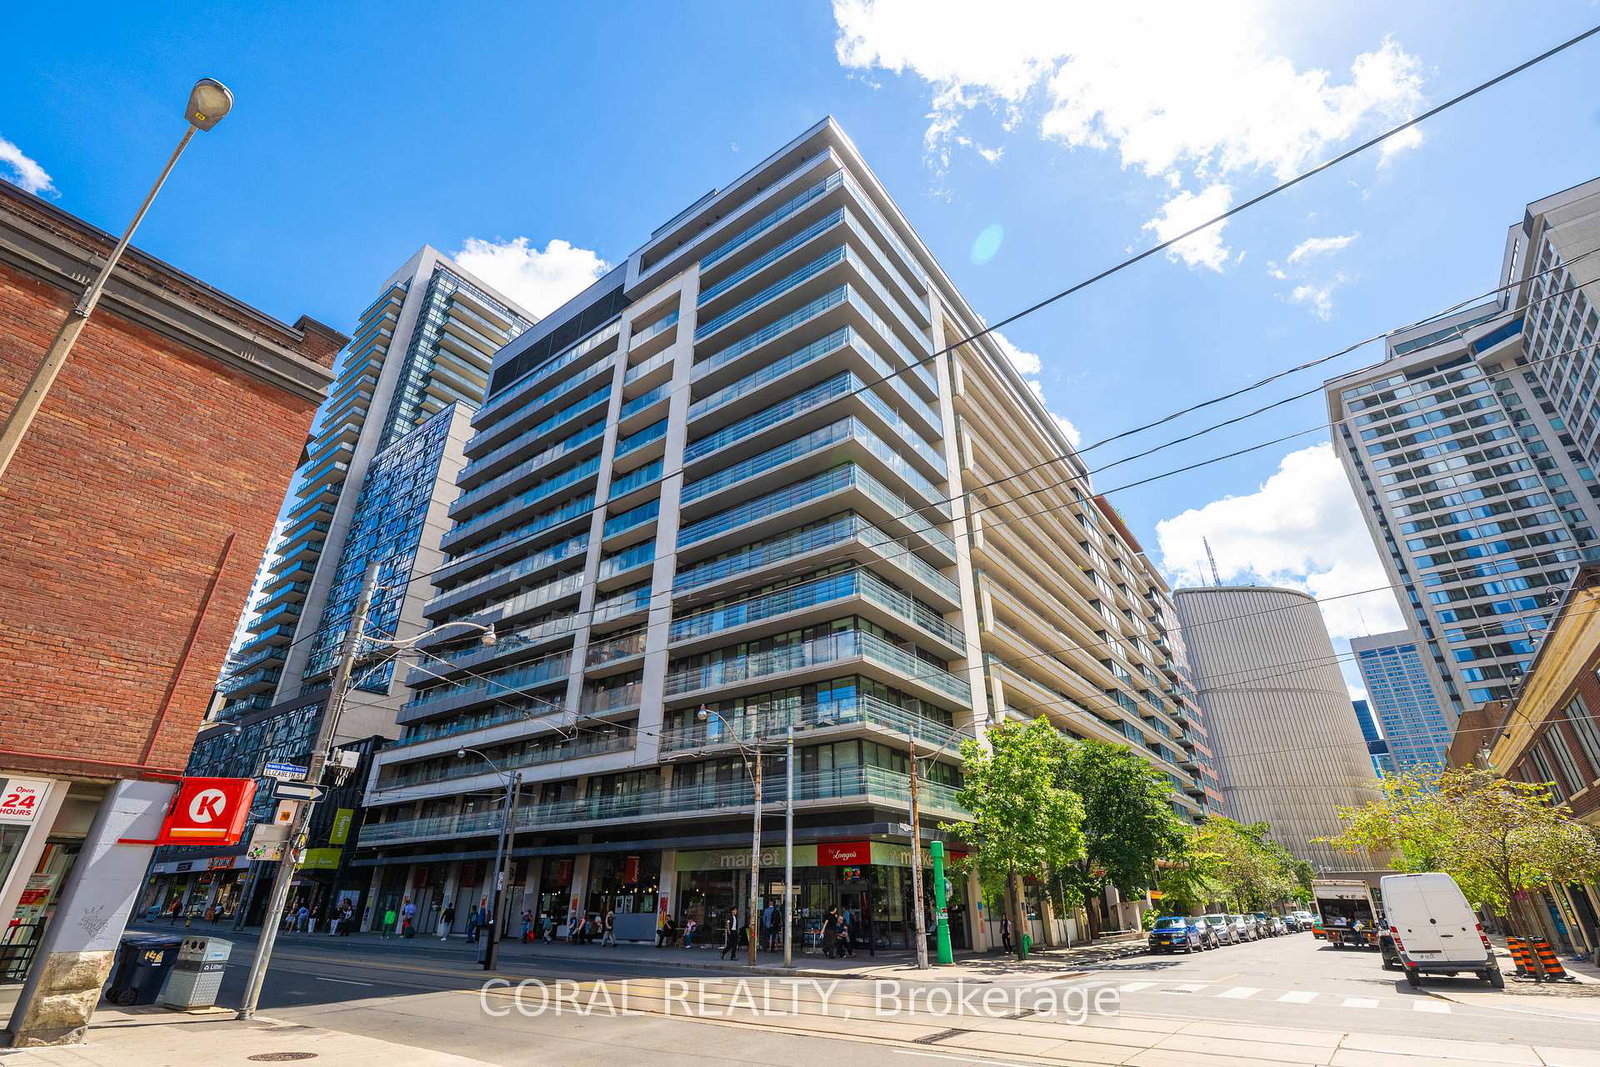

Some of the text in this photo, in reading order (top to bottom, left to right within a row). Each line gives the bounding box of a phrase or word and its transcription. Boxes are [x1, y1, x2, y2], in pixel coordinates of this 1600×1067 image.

[265, 770, 296, 778] ELIZABETH
[16, 786, 35, 794] Open
[2, 794, 36, 809] 24
[196, 796, 217, 816] K
[0, 808, 32, 816] HOURS
